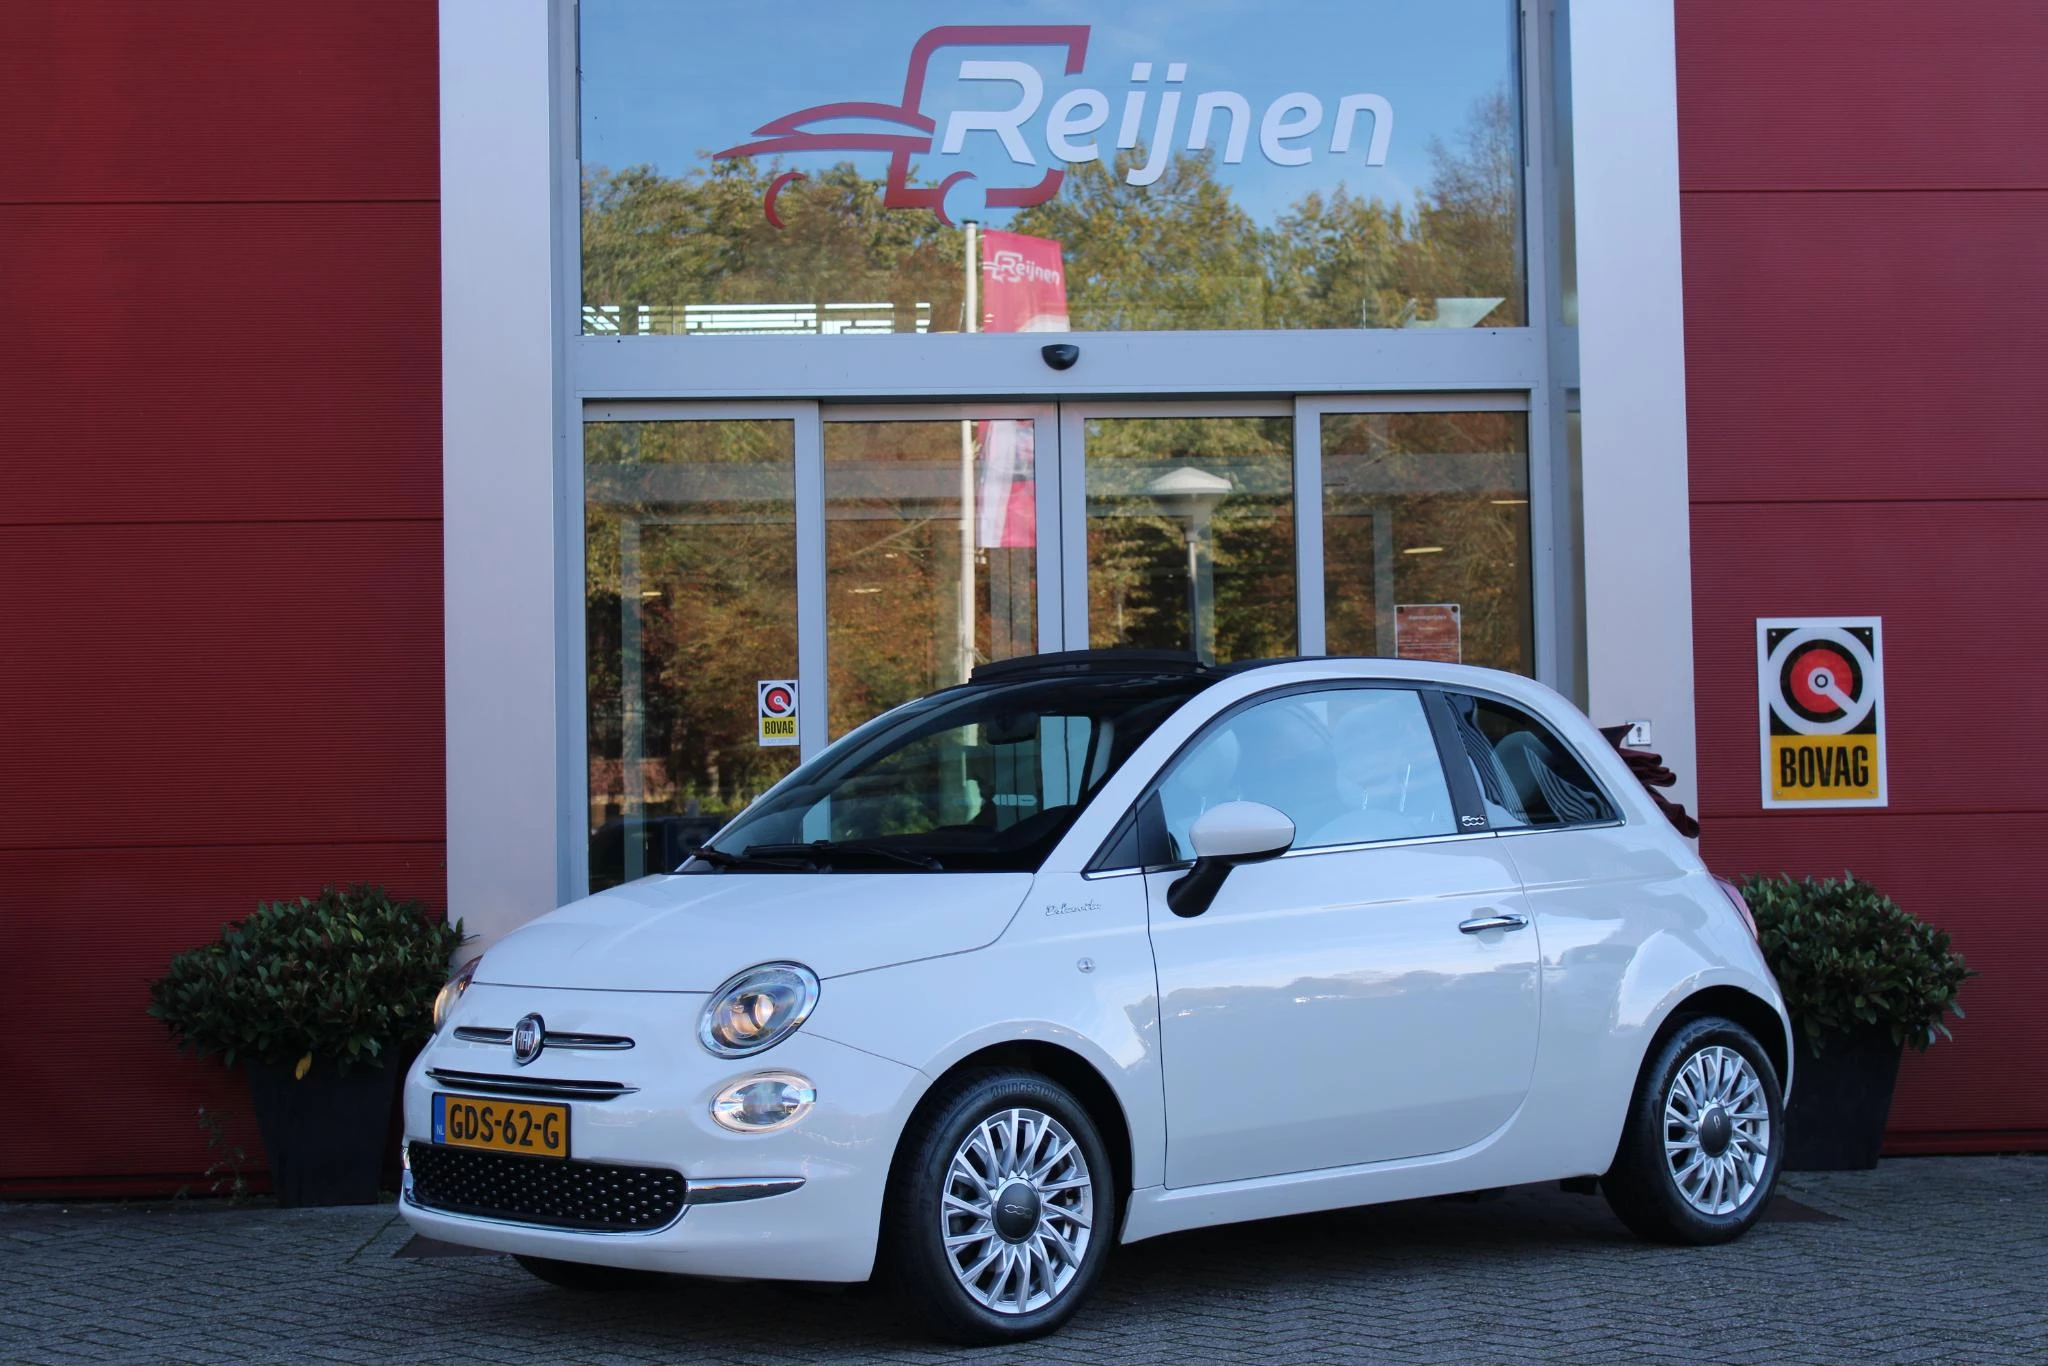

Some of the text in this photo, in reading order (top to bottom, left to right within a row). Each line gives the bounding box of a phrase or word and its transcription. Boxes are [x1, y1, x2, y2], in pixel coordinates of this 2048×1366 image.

[941, 60, 1394, 186] Reijnen
[1001, 256, 1060, 287] Reijnen
[764, 720, 794, 735] BOVAG
[1779, 745, 1870, 788] BOVAG
[516, 1030, 534, 1051] FIAT
[436, 1124, 445, 1136] NL
[449, 1103, 560, 1150] GDS-62-G
